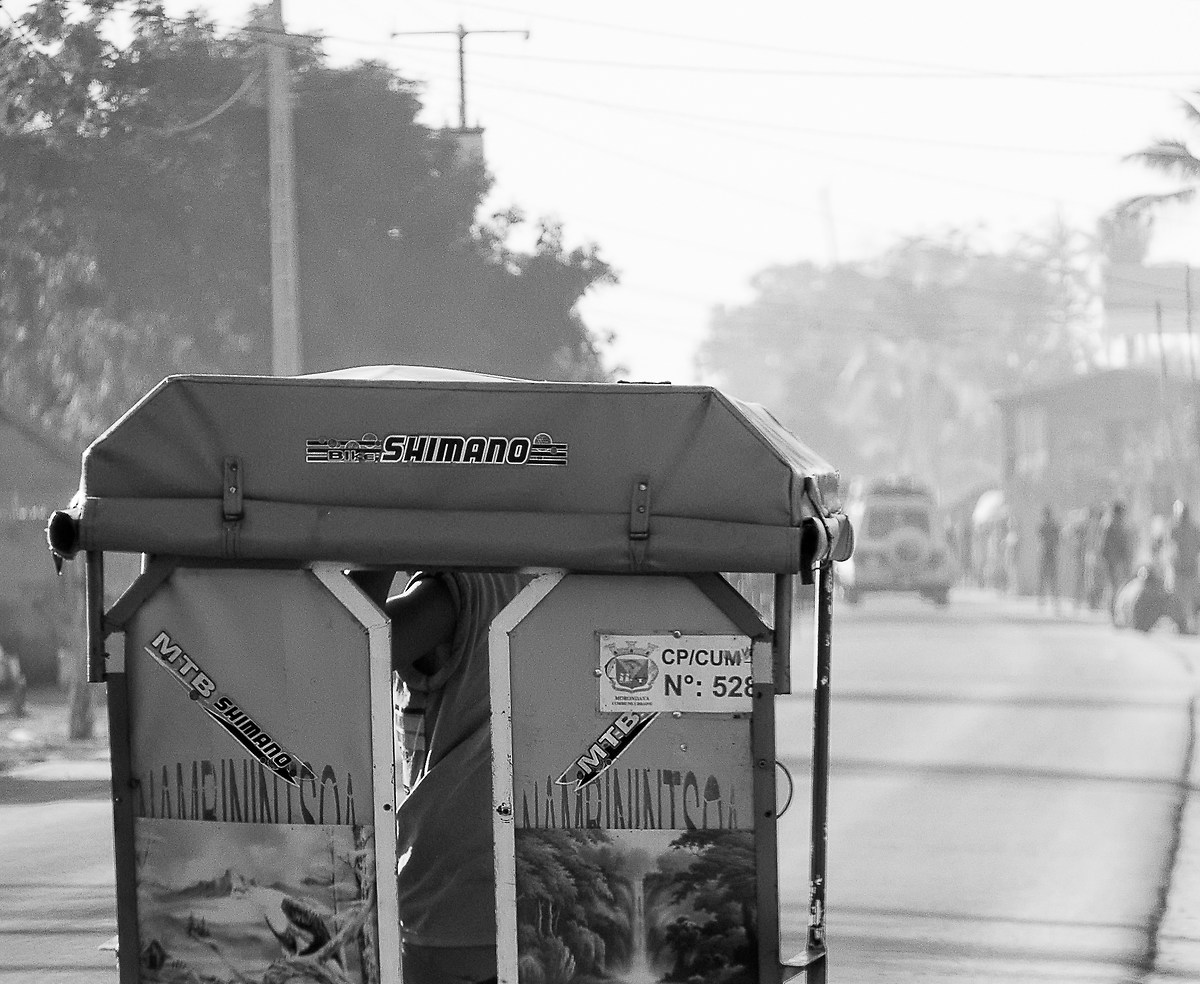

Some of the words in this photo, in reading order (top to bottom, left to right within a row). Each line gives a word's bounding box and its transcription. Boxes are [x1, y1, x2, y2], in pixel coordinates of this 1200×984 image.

[380, 435, 531, 464] SHIMANO
[151, 631, 217, 698] MTB
[213, 696, 293, 769] SHIMANO
[712, 675, 754, 697] 528
[576, 711, 641, 775] MTB
